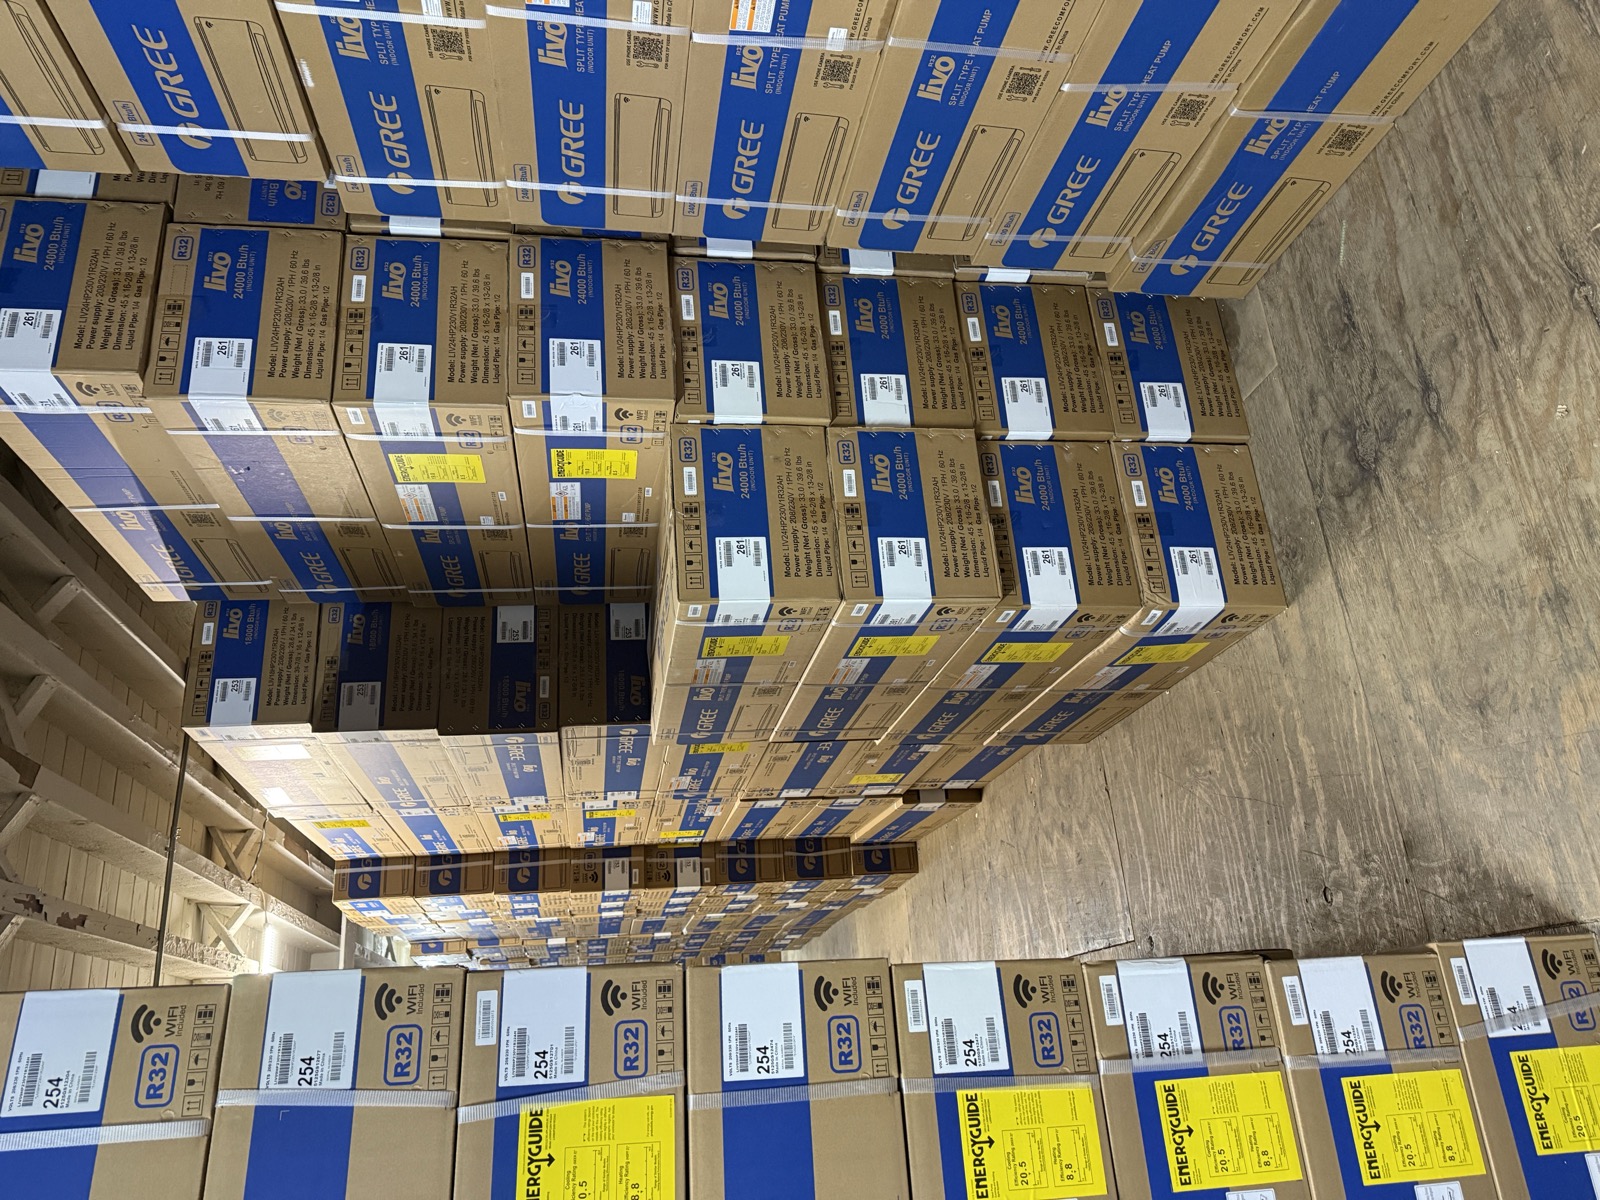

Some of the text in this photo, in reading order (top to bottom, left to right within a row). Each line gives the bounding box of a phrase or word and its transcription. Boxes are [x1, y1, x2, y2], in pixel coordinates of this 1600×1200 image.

[383, 23, 400, 66] (INDOOR UNIT)
[949, 84, 964, 105] SPLIT
[958, 59, 974, 81] TYPE
[977, 9, 992, 33] PUMP
[131, 23, 200, 118] GREE
[576, 49, 585, 72] SPLIT
[730, 45, 763, 91] livo
[928, 55, 936, 67] R32
[1229, 59, 1242, 73] China
[917, 56, 956, 102] livo
[958, 66, 980, 106] (INDOOR UNIT)
[368, 91, 411, 168] GREE
[1271, 139, 1289, 160] SPLIT
[1287, 120, 1304, 137] TYP
[1320, 71, 1341, 94] PUMP
[559, 99, 585, 177] GREE
[341, 157, 353, 173] Btu/h
[731, 120, 765, 194] GREE
[896, 131, 941, 204] GREE
[852, 192, 865, 209] Btu/h
[1048, 154, 1101, 224] GREE
[324, 195, 336, 213] R32
[1191, 181, 1253, 251] GREE
[13, 223, 45, 263] livo
[43, 216, 65, 271] 24000 Btu/h
[176, 239, 189, 257] R32
[522, 247, 532, 265] R32
[204, 252, 232, 291] livo
[356, 250, 365, 268] R32
[461, 260, 469, 268] Hz
[382, 262, 407, 301] livo
[411, 255, 422, 307] 24000 Btu/h
[421, 262, 430, 300] (INDOOR UNIT)
[461, 270, 468, 278] 60
[550, 260, 572, 297] livo
[681, 271, 690, 288] R32
[460, 283, 468, 296] 1PH
[483, 281, 491, 301] 13-2/8
[965, 295, 975, 311] R32
[23, 311, 35, 326] 261
[482, 308, 491, 327] 16-2/8
[855, 298, 876, 333] livo
[877, 292, 890, 339] 24000 Btu/h
[217, 341, 228, 355] 261
[448, 286, 458, 382] Model: LIV24HP230V1R32AH
[460, 334, 469, 359] supply:
[483, 335, 490, 343] 45
[570, 341, 580, 355] 261
[399, 346, 408, 360] 261
[482, 345, 490, 383] Dimension:
[459, 361, 467, 383] Power
[731, 363, 740, 377] 261
[879, 376, 888, 389] 261
[1020, 379, 1029, 392] 261
[1157, 384, 1167, 397] 261
[555, 449, 565, 477] ENERGYGUIDE
[683, 440, 693, 460] R32
[712, 452, 734, 491] livo
[737, 443, 750, 499] 24000 Btu/h
[869, 454, 893, 493] livo
[893, 446, 908, 500] 24000 Btu/h
[1127, 456, 1137, 474] R32
[1013, 467, 1035, 504] livo
[1155, 467, 1180, 504] livo
[736, 540, 746, 554] 261
[897, 540, 907, 554] 261
[1041, 549, 1051, 564] 261
[1188, 549, 1198, 563] 261
[440, 555, 465, 586] GREE
[574, 553, 591, 583] GREE
[207, 603, 215, 616] R32
[222, 608, 243, 639] livo
[330, 608, 339, 622] R32
[231, 680, 239, 692] 253
[357, 684, 365, 696] 253
[1563, 950, 1575, 975] WIFI
[1570, 950, 1580, 975] Included
[632, 981, 641, 1010] WIFI
[842, 977, 852, 1006] WIFI
[1039, 976, 1050, 1004] WIFI
[1047, 975, 1056, 1003] Included
[1226, 973, 1238, 1000] WIFI
[1234, 972, 1243, 999] Included
[1404, 972, 1415, 998] WIFI
[1411, 971, 1420, 997] Included
[406, 985, 418, 1015] WIFI
[416, 984, 425, 1015] Included
[164, 1006, 179, 1037] WIFI
[176, 1005, 186, 1037] Included
[1226, 1012, 1246, 1049] R32
[1407, 1010, 1426, 1048] R32
[1507, 1006, 1523, 1030] 24
[624, 1027, 639, 1071] R32
[837, 1022, 853, 1065] R32
[962, 1039, 977, 1067] 254
[1037, 1020, 1056, 1060] R32
[1157, 1033, 1172, 1057] 254
[1341, 1030, 1355, 1054] 254
[393, 1032, 413, 1077] R32
[534, 1050, 548, 1079] 254
[756, 1045, 770, 1074] 254
[145, 1052, 170, 1100] R32
[298, 1056, 315, 1086] 254
[43, 1077, 63, 1109] 254
[1517, 1054, 1553, 1149] ENERGYGUIDE
[1163, 1084, 1192, 1186] ENERGYGUIDE
[1350, 1080, 1381, 1179] ENERGYGUIDE
[1573, 1115, 1585, 1137] 20.5
[966, 1093, 990, 1199] ENERGYGUIDE
[1261, 1150, 1271, 1166] 8.8
[1404, 1143, 1415, 1167] 20.5
[1446, 1145, 1455, 1161] 8.8
[1019, 1161, 1029, 1186] 20.5
[1065, 1163, 1074, 1180] 8.8
[1218, 1148, 1228, 1173] 20.5
